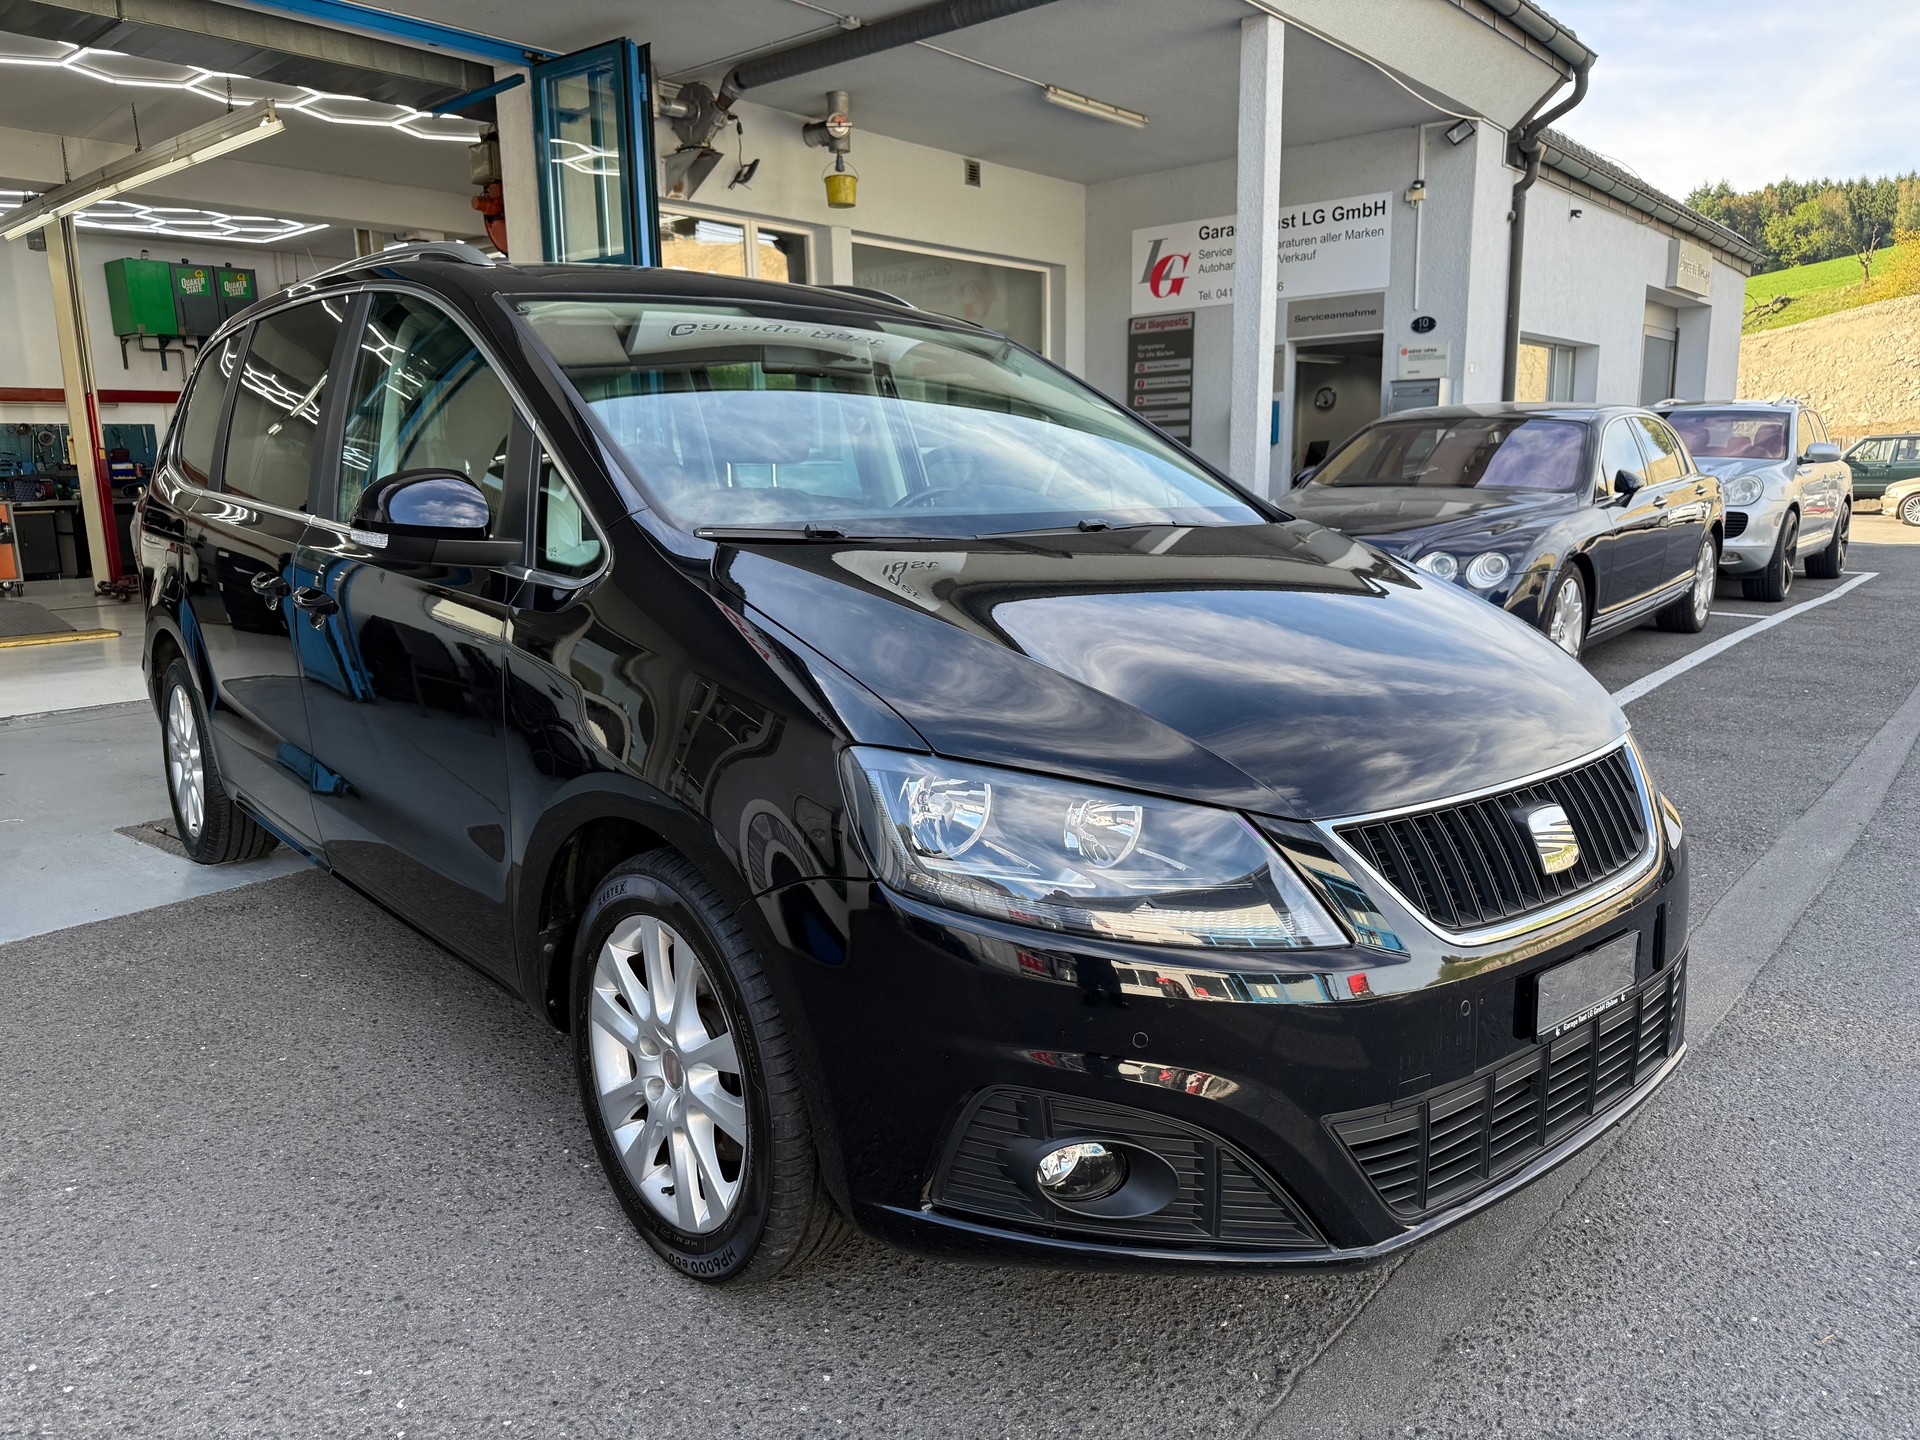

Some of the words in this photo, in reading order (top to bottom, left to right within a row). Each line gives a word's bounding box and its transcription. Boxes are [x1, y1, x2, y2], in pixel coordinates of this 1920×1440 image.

[1198, 225, 1236, 240] Gara
[1278, 213, 1296, 230] st
[1302, 208, 1325, 227] LG
[1331, 199, 1386, 222] GmbH
[1198, 247, 1233, 260] Service
[1278, 236, 1317, 250] araturen
[1319, 232, 1342, 244] aller
[1345, 227, 1384, 241] Marken
[1278, 249, 1317, 264] Verkauf
[181, 277, 206, 289] QUAKER
[185, 285, 204, 294] STATE
[224, 280, 248, 292] QUAKER
[228, 288, 247, 297] STATE
[1198, 291, 1213, 301] Tel.
[1216, 288, 1233, 299] 041
[1294, 309, 1377, 323] Serviceannahme
[1419, 318, 1429, 328] 10
[1134, 321, 1147, 331] Car
[1148, 316, 1189, 330] Diagnostic
[1563, 1020, 1578, 1031] Garage
[1578, 1015, 1587, 1023] Rast
[1594, 1004, 1606, 1015] GmbH
[668, 1253, 689, 1269] eco
[690, 1245, 737, 1274] HP6000
